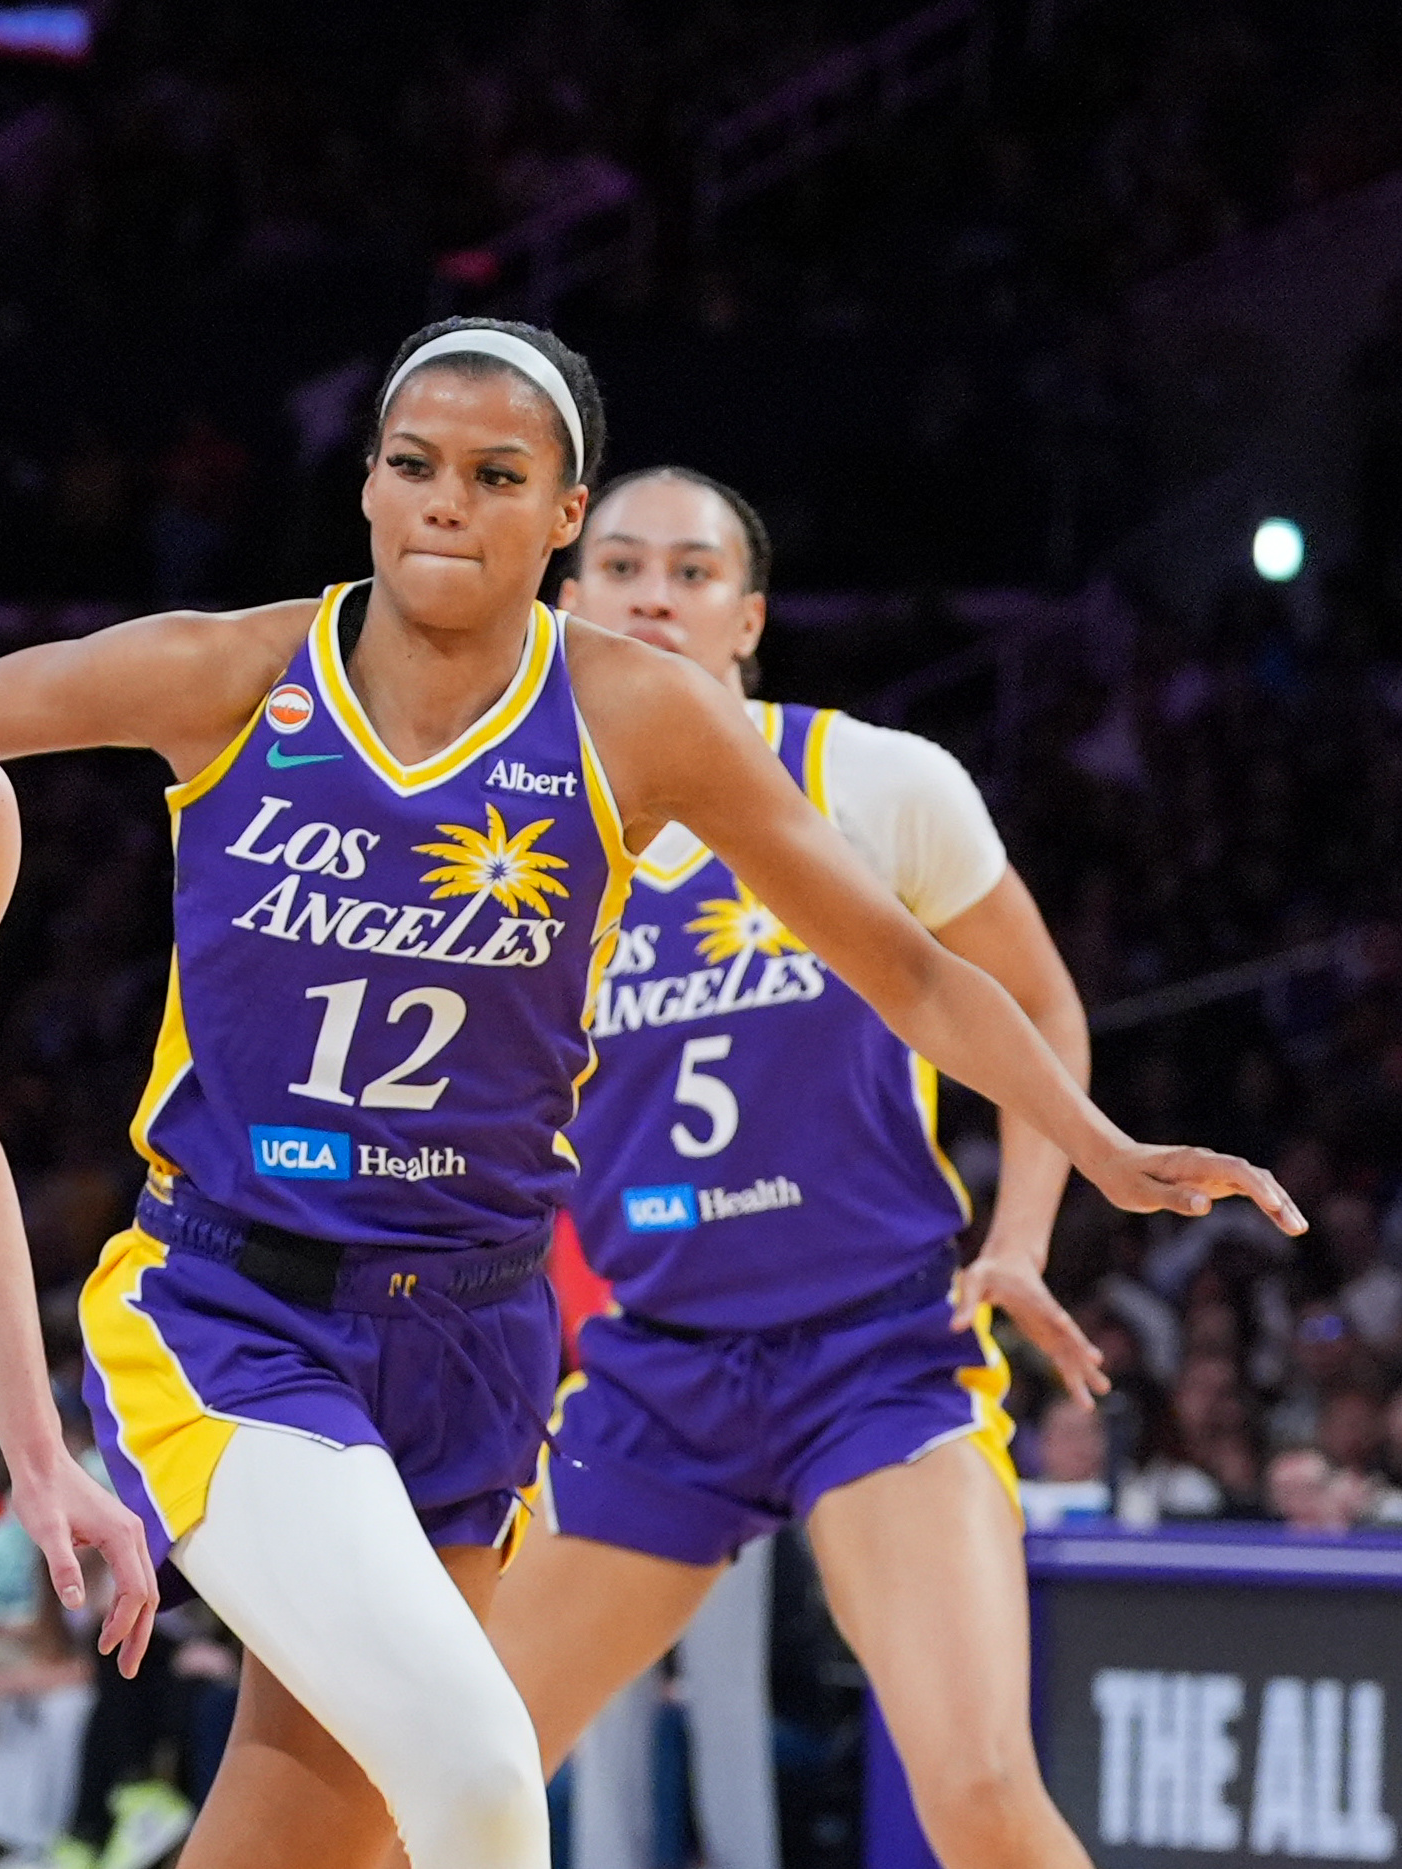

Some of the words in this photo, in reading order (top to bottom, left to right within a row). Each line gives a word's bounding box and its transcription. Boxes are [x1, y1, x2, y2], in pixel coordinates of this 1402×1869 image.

[486, 759, 578, 798] Albert
[225, 795, 381, 881] LOS
[232, 873, 566, 968] ANGELES
[287, 977, 468, 1111] 12
[670, 1033, 740, 1159] 5
[261, 1139, 337, 1171] UCLA
[357, 1144, 467, 1182] Health
[1091, 1669, 1247, 1852] THE
[1250, 1675, 1397, 1863] ALL
